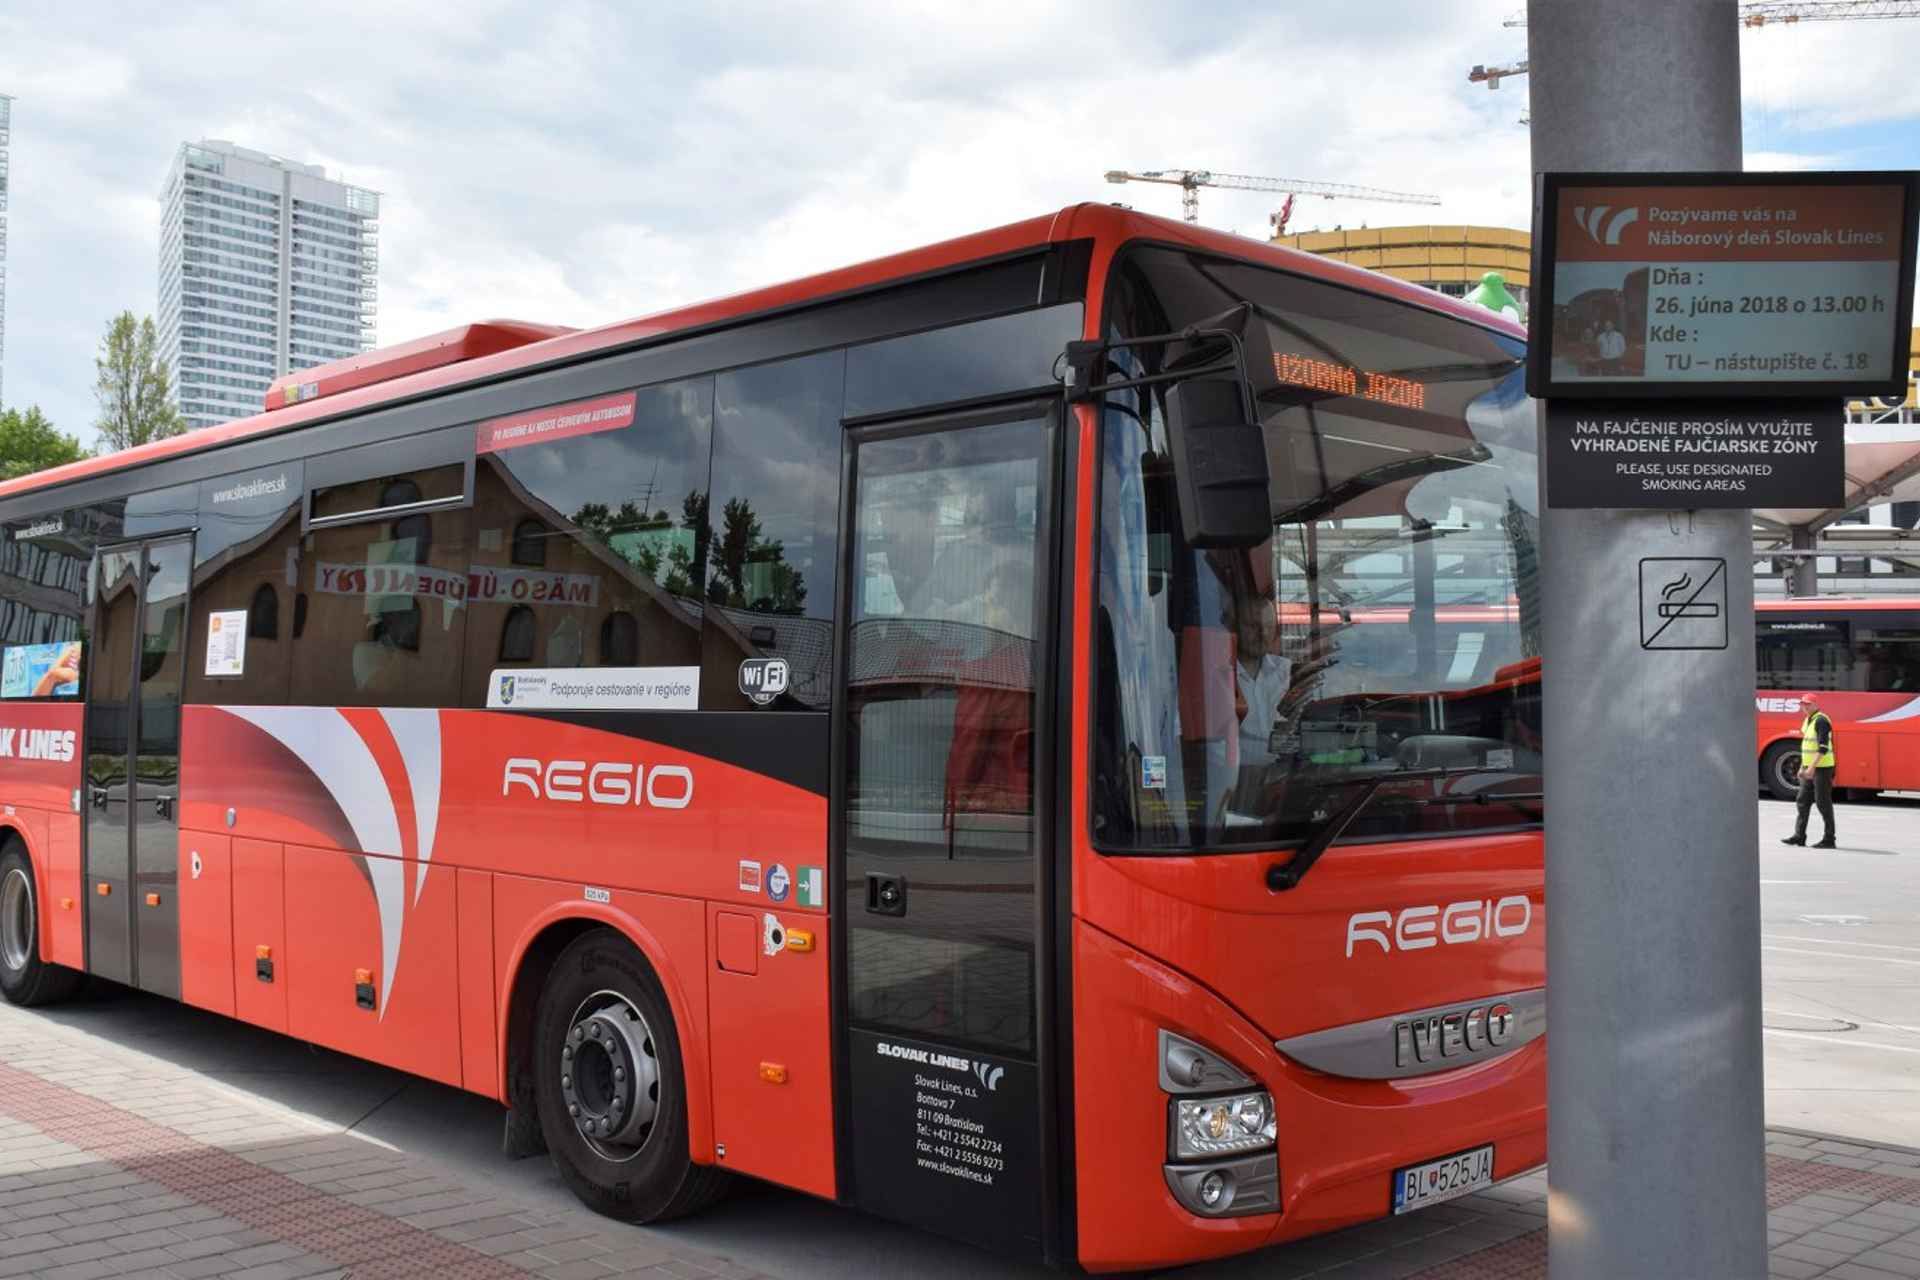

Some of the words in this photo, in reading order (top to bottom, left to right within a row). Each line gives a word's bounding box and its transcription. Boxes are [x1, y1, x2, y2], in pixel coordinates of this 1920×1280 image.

[1649, 206, 1739, 225] Pozývame
[1743, 207, 1771, 221] vás
[1776, 210, 1797, 221] na
[1648, 229, 1733, 249] Náborový
[1738, 229, 1771, 245] deň
[1776, 229, 1833, 245] Slovak
[1838, 229, 1884, 245] Lines
[1653, 267, 1691, 285] Dňa
[1655, 298, 1684, 314] 26.
[1689, 296, 1734, 317] júna
[1740, 296, 1788, 313] 2018
[1793, 300, 1806, 313] o
[1813, 296, 1867, 313] 13.00
[1872, 295, 1885, 313] h
[1650, 325, 1687, 343] Kde
[1666, 354, 1692, 370] TU
[1715, 352, 1816, 375] nástupište
[1822, 353, 1838, 370] č.
[1844, 353, 1868, 370] 18
[1364, 371, 1425, 409] JAZDA
[1576, 421, 1599, 436] NA
[1603, 417, 1677, 436] FAJČENIE
[1682, 418, 1744, 436] PROSÍM
[1748, 418, 1813, 437] VYUŽITE
[1570, 434, 1670, 453] VYHRADENÉ
[1675, 435, 1769, 453] FAJČIARSKE
[1773, 437, 1818, 454] ZÓNY
[1616, 463, 1664, 477] PLEASE,
[1667, 464, 1691, 476] USE
[1693, 463, 1772, 476] DESIGNATED
[1642, 478, 1701, 491] SMOKING
[1703, 479, 1746, 491] AREAS
[550, 682, 593, 699] Podporuje
[596, 683, 645, 697] cestovanie
[646, 686, 653, 696] v
[654, 683, 692, 699] regióne
[1755, 697, 1801, 713] NES
[19, 728, 76, 762] LINES
[503, 757, 694, 809] REGIO
[1345, 895, 1531, 958] REGIO
[1395, 1002, 1514, 1068] IVECO
[876, 1042, 928, 1063] SLOVAK
[930, 1053, 969, 1072] LINES
[915, 1073, 940, 1089] Slovak
[941, 1080, 963, 1096] Lines,
[949, 1099, 956, 1109] 7
[917, 1108, 931, 1122] 811
[933, 1112, 944, 1125] 09
[945, 1113, 984, 1134] Bratislava
[933, 1128, 952, 1143] +421
[954, 1131, 959, 1143] 2
[960, 1135, 980, 1150] 5542
[981, 1140, 1003, 1154] 2734
[934, 1145, 953, 1159] +421
[955, 1148, 961, 1160] 2
[961, 1150, 982, 1165] 5556
[983, 1155, 1004, 1171] 9273
[917, 1157, 993, 1185] www.slovaklines.sk
[1407, 1171, 1428, 1200] BL
[1439, 1151, 1490, 1191] 525JA
